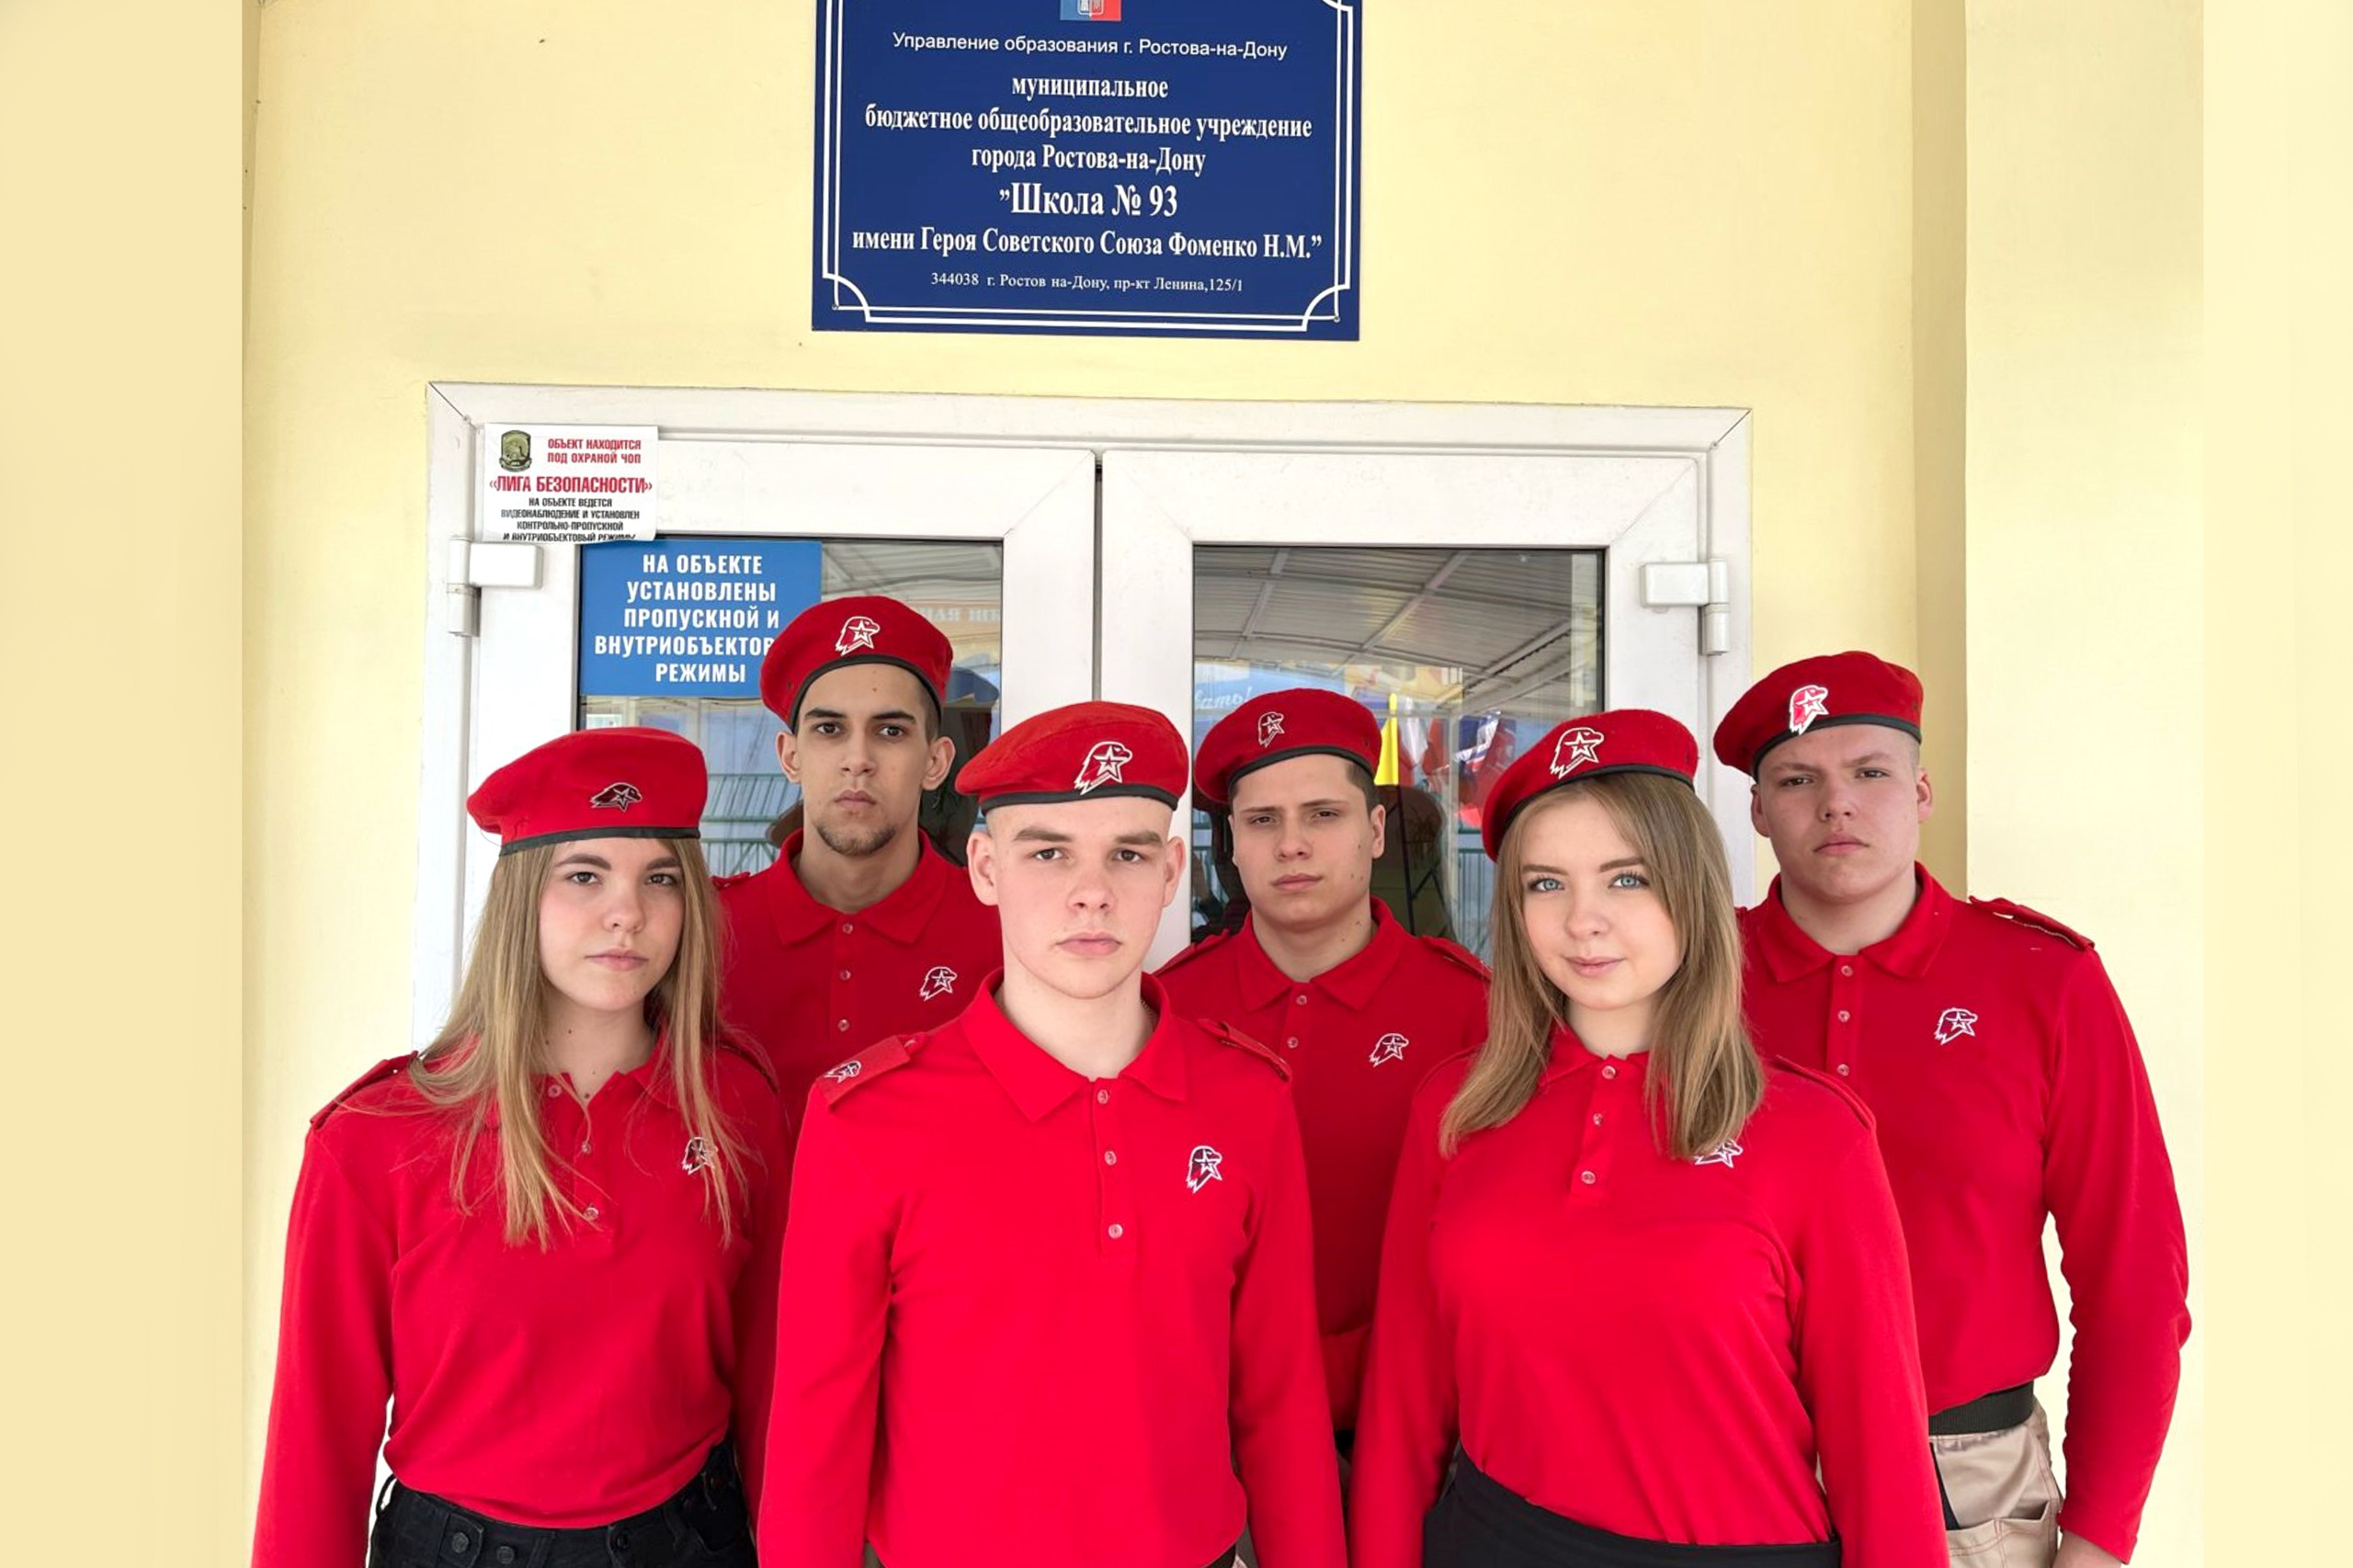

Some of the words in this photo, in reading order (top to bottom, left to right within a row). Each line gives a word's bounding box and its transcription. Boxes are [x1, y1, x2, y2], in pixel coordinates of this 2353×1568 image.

[892, 31, 999, 51] Управление
[1004, 35, 1119, 55] образования
[1123, 41, 1133, 54] г.
[1139, 38, 1288, 61] Ростова-на-Дону
[1012, 77, 1168, 102] муниципальное
[865, 103, 973, 131] бюджетное
[978, 107, 1191, 139] общеобразовательное
[1196, 118, 1313, 142] учреждение
[972, 149, 1037, 174] города
[1042, 143, 1207, 177] Ростова-на-Дону
[1111, 184, 1142, 216] №
[1149, 185, 1177, 217] 93
[852, 232, 915, 250] имени
[920, 226, 977, 257] Героя
[983, 227, 1095, 254] Советского
[1099, 230, 1163, 256] Союза
[1168, 232, 1257, 257] Фоменко
[931, 272, 979, 286] 344038
[986, 277, 995, 286] г.
[1000, 274, 1047, 288] Ростов
[1051, 275, 1110, 292] на-Дону,
[1113, 279, 1151, 292] пр-кт
[547, 437, 584, 449] ОБЪЕКТ
[585, 438, 642, 451] НАХОДИТСЯ
[547, 451, 568, 464] ПОД
[571, 451, 618, 464] ОХРАНОЙ
[620, 452, 642, 464] ЧОП
[529, 497, 540, 506] НА
[541, 497, 576, 507] ОБЪЕКТЕ
[577, 497, 613, 508] ВЕДЕТСЯ
[501, 508, 580, 520] ВИДЕОНАБЛЮДЕНИЕ
[582, 509, 589, 519] И
[590, 509, 640, 519] УСТАНОВЛЕН
[517, 520, 624, 531] КОНТРОЛЬНО-ПРОПУСКНОЙ
[642, 554, 669, 574] НА
[676, 554, 763, 574] ОБЪЕКТЕ
[626, 581, 776, 604] УСТАНОВЛЕНЫ
[623, 605, 759, 631] ПРОПУСКНОЙ
[767, 609, 779, 629] И
[655, 663, 746, 683] РЕЖИМЫ
